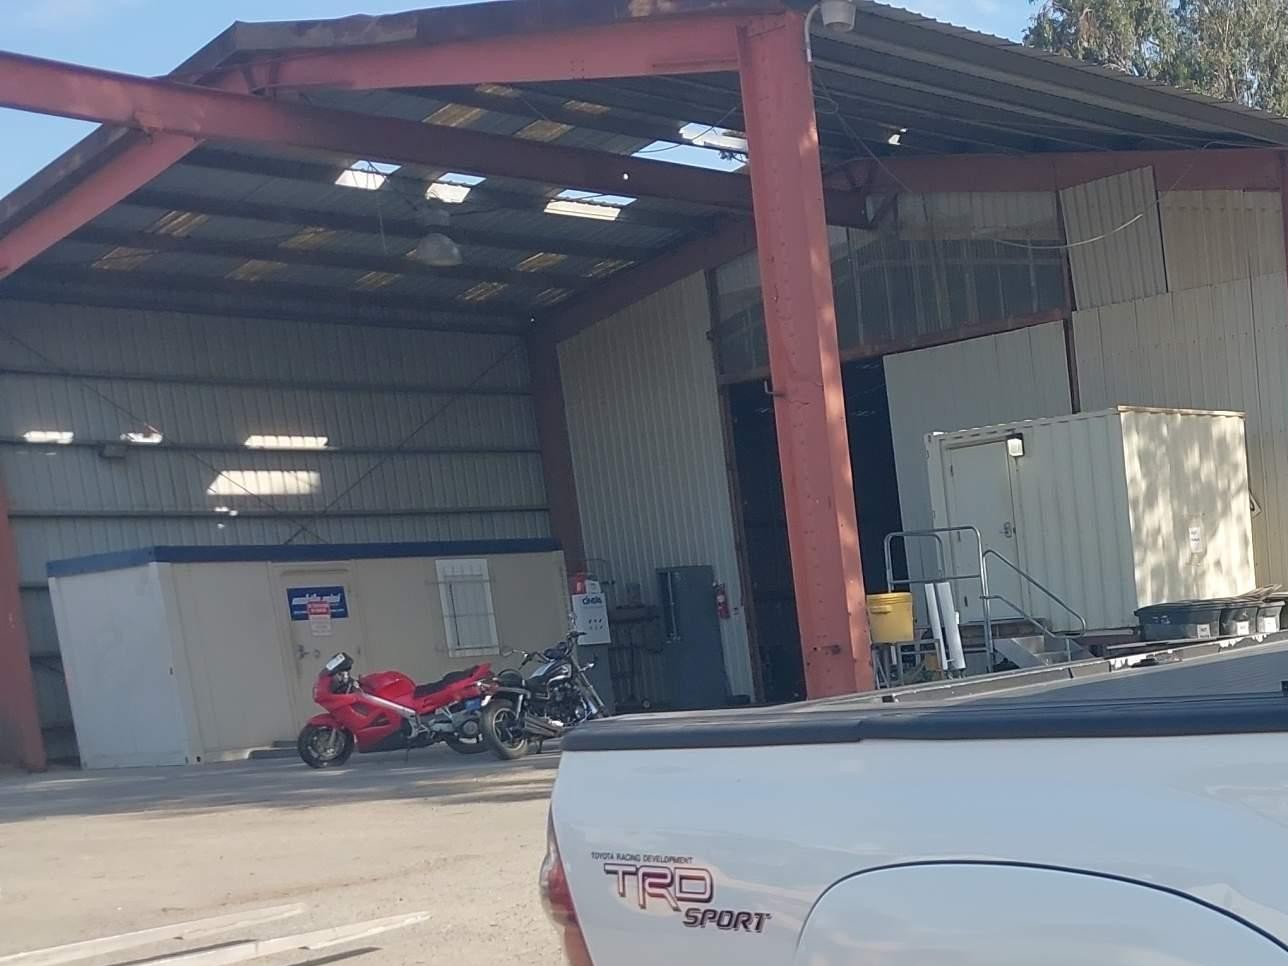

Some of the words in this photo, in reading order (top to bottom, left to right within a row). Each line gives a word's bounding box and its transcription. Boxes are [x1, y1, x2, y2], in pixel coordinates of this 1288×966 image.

[591, 851, 615, 861] TOYOTA
[616, 852, 641, 863] RACING
[642, 854, 694, 865] DEVELOPMENT
[603, 862, 714, 913] TRD
[683, 907, 767, 934] SPORT
